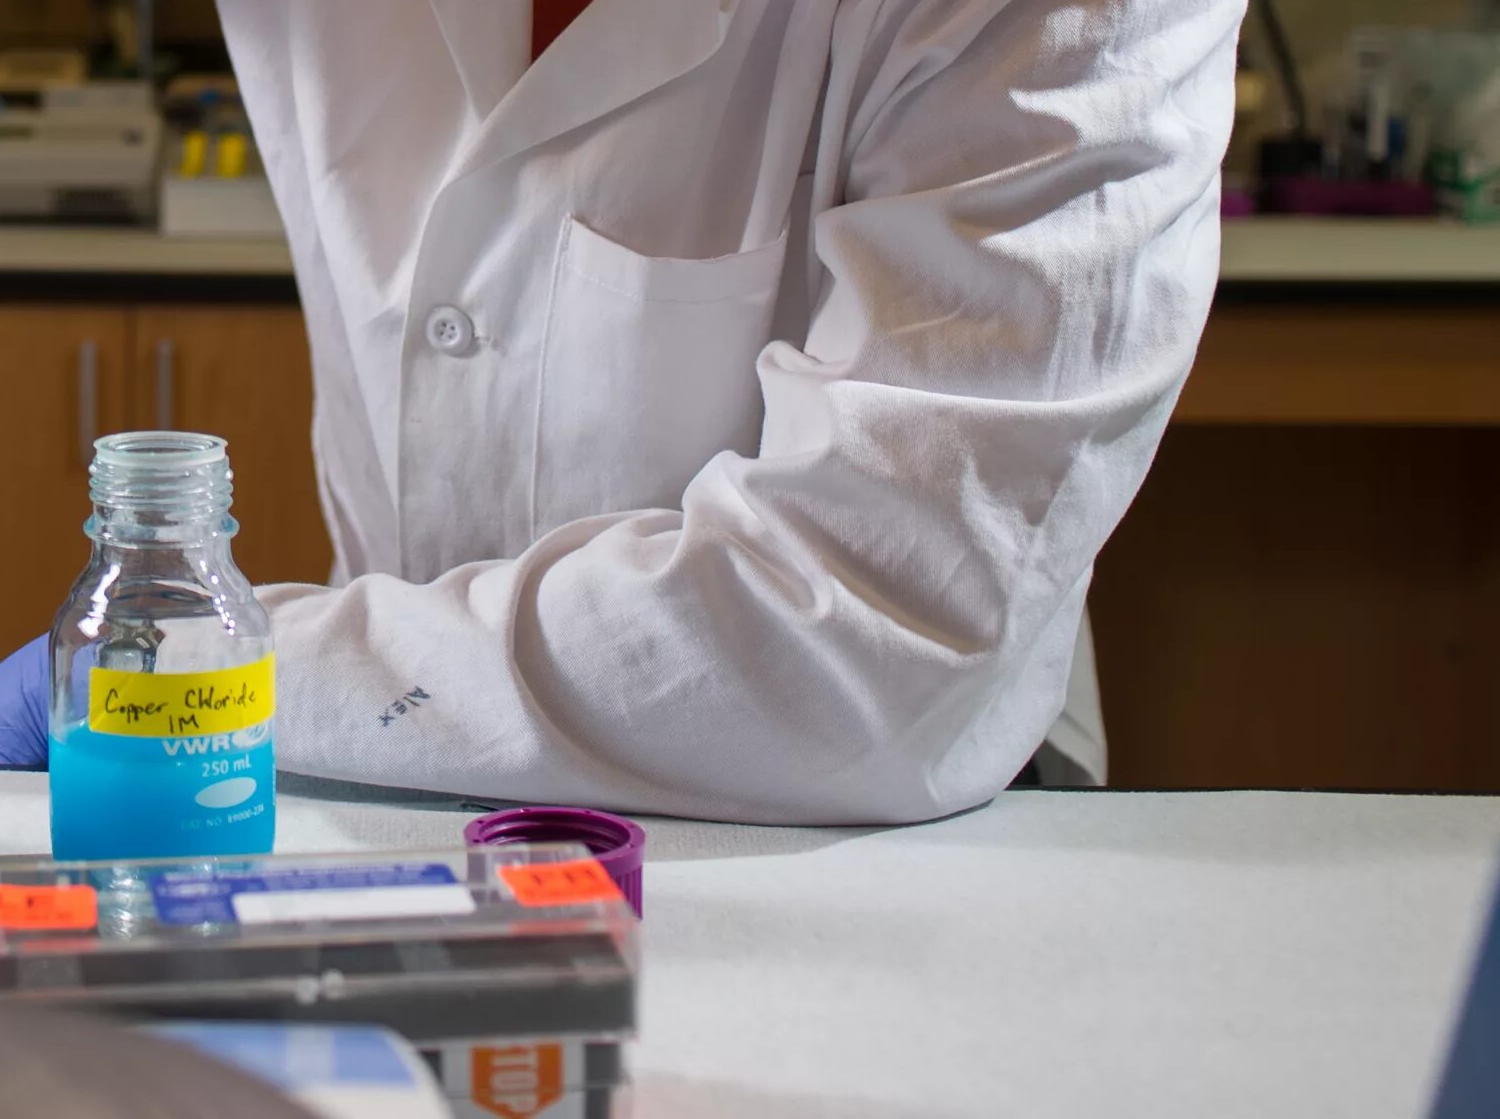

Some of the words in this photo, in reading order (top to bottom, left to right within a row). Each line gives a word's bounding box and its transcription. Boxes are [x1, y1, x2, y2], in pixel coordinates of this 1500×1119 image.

[104, 688, 170, 724] Copper
[184, 683, 257, 711] Chloride
[168, 713, 200, 734] 1M
[162, 734, 231, 757] VWR
[201, 758, 230, 778] 250
[232, 753, 253, 773] mL
[492, 1047, 541, 1113] TOP
